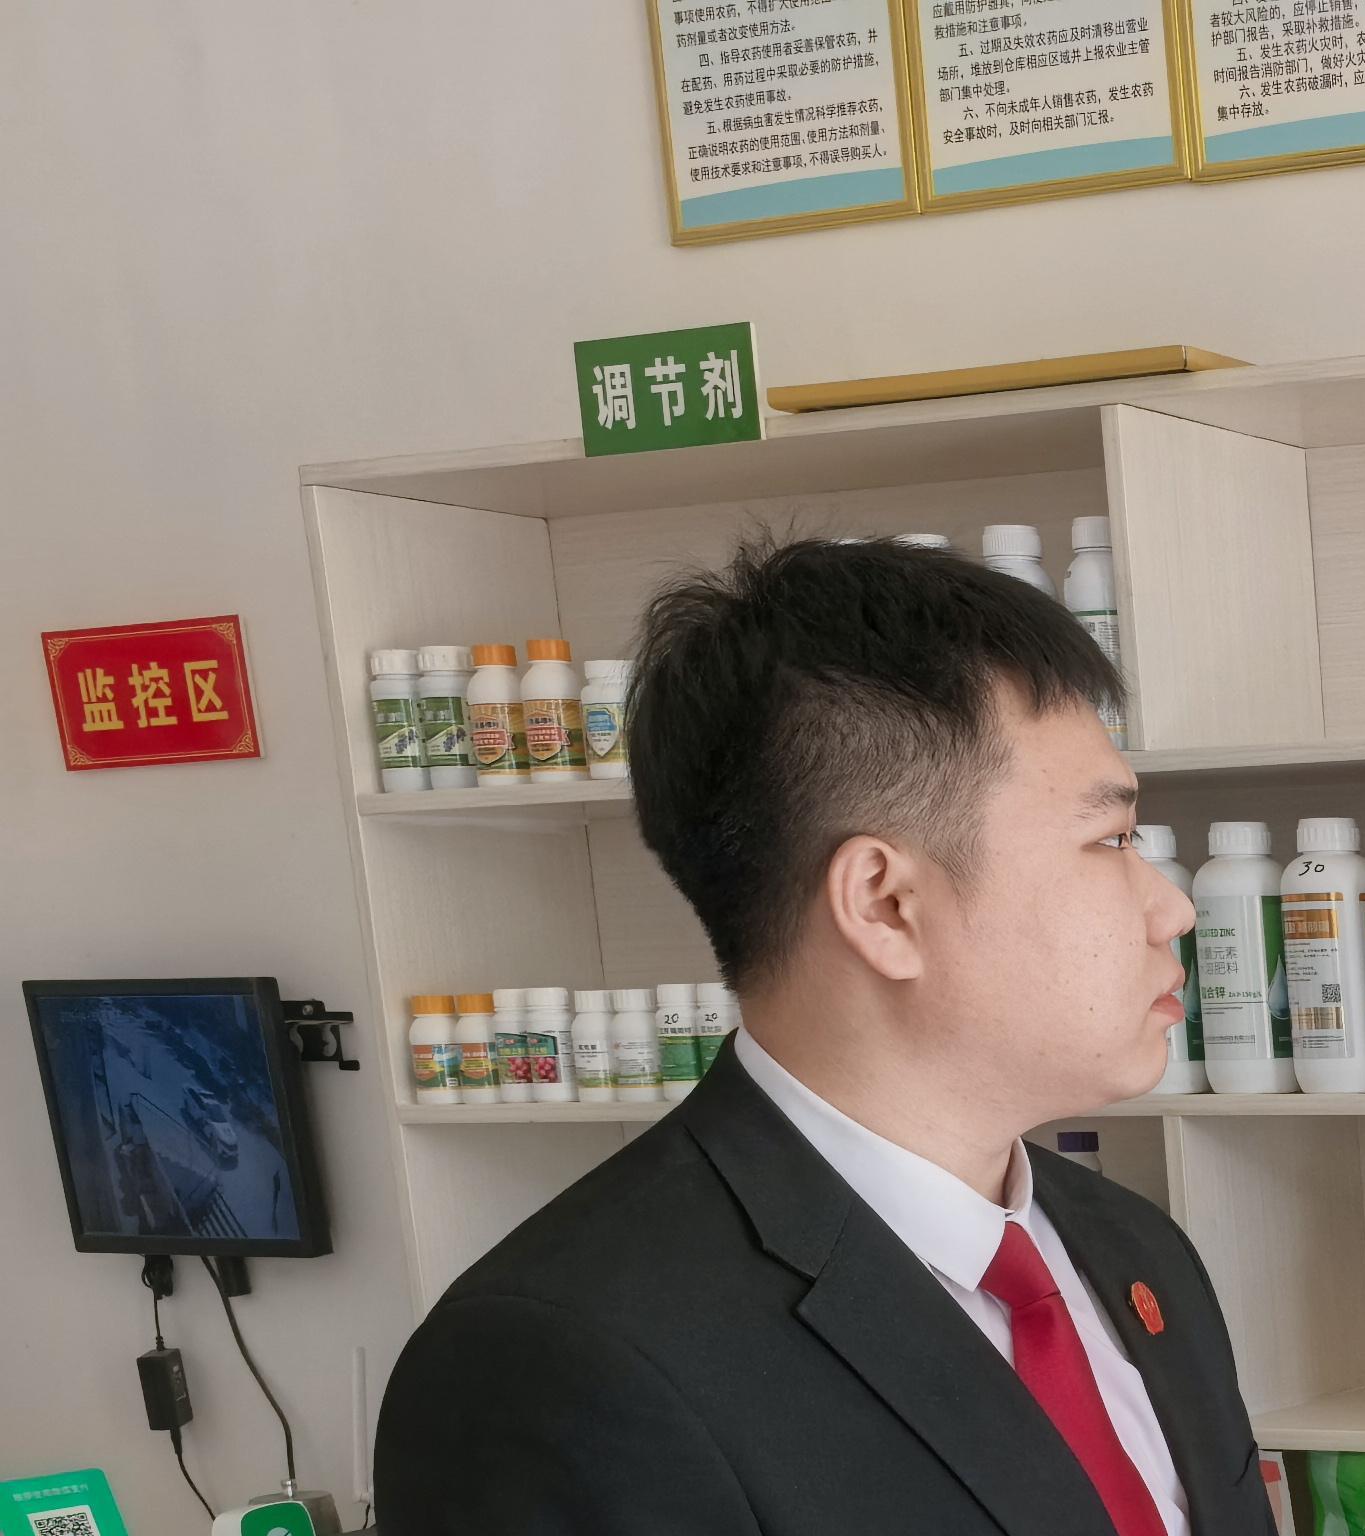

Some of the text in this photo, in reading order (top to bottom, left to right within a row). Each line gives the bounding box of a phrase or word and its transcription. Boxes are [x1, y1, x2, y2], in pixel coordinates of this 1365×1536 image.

[592, 350, 744, 431] 调节剂
[76, 659, 229, 733] 监控区
[1299, 861, 1325, 876] 30
[1200, 946, 1238, 959] 量元素
[1202, 962, 1238, 975] 溶肥料
[663, 1012, 679, 1025] 20
[704, 1012, 718, 1022] 20
